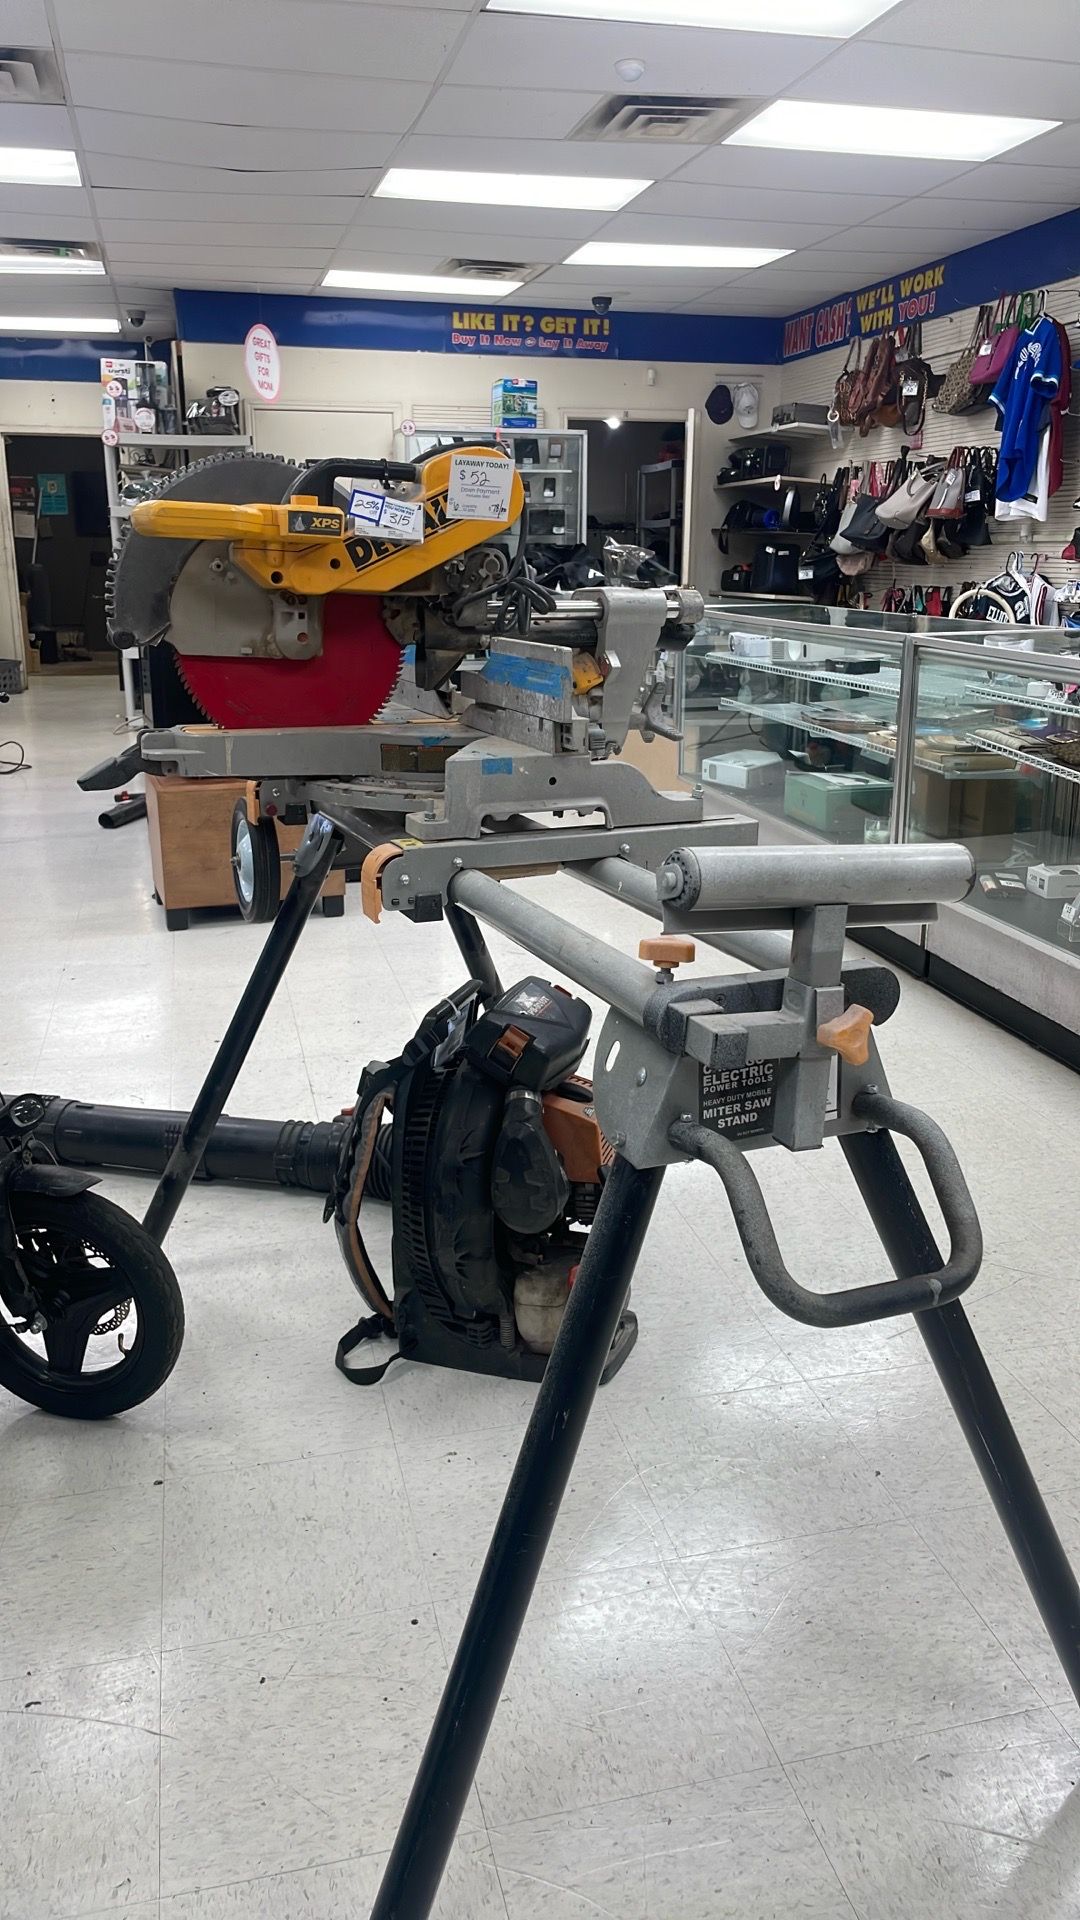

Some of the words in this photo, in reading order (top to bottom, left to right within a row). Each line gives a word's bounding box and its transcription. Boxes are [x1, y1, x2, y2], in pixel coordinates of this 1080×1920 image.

[857, 285, 894, 313] WE'LL
[901, 265, 945, 298] WORK
[861, 306, 893, 334] WITH
[898, 291, 936, 322] YOU!
[452, 312, 495, 330] LIKE
[503, 314, 534, 332] IT?
[540, 316, 577, 334] GET
[583, 318, 610, 335] IT!
[252, 336, 271, 349] GREAT
[452, 333, 476, 346] Buy
[480, 334, 490, 345] It
[494, 335, 522, 346] Now
[539, 336, 560, 350] Lay
[563, 338, 573, 348] It
[576, 339, 608, 351] Away
[784, 313, 815, 358] WANT
[255, 352, 270, 363] GIFTS
[258, 366, 269, 377] FOR
[455, 459, 485, 468] LAYAWAY
[486, 461, 509, 469] TODAY!
[470, 470, 490, 486] 52
[353, 499, 379, 511] 25%
[310, 517, 340, 529] XPS
[389, 512, 411, 526] 315
[703, 1063, 774, 1087] ELECTRIC
[703, 1081, 738, 1095] POWER
[741, 1074, 773, 1087] TOOLS
[703, 1096, 726, 1107] HEAVY
[727, 1092, 745, 1103] DUTY
[746, 1087, 772, 1098] MOBILE
[703, 1103, 742, 1120] MITER
[744, 1096, 772, 1111] SAW
[717, 1112, 758, 1129] STAND
